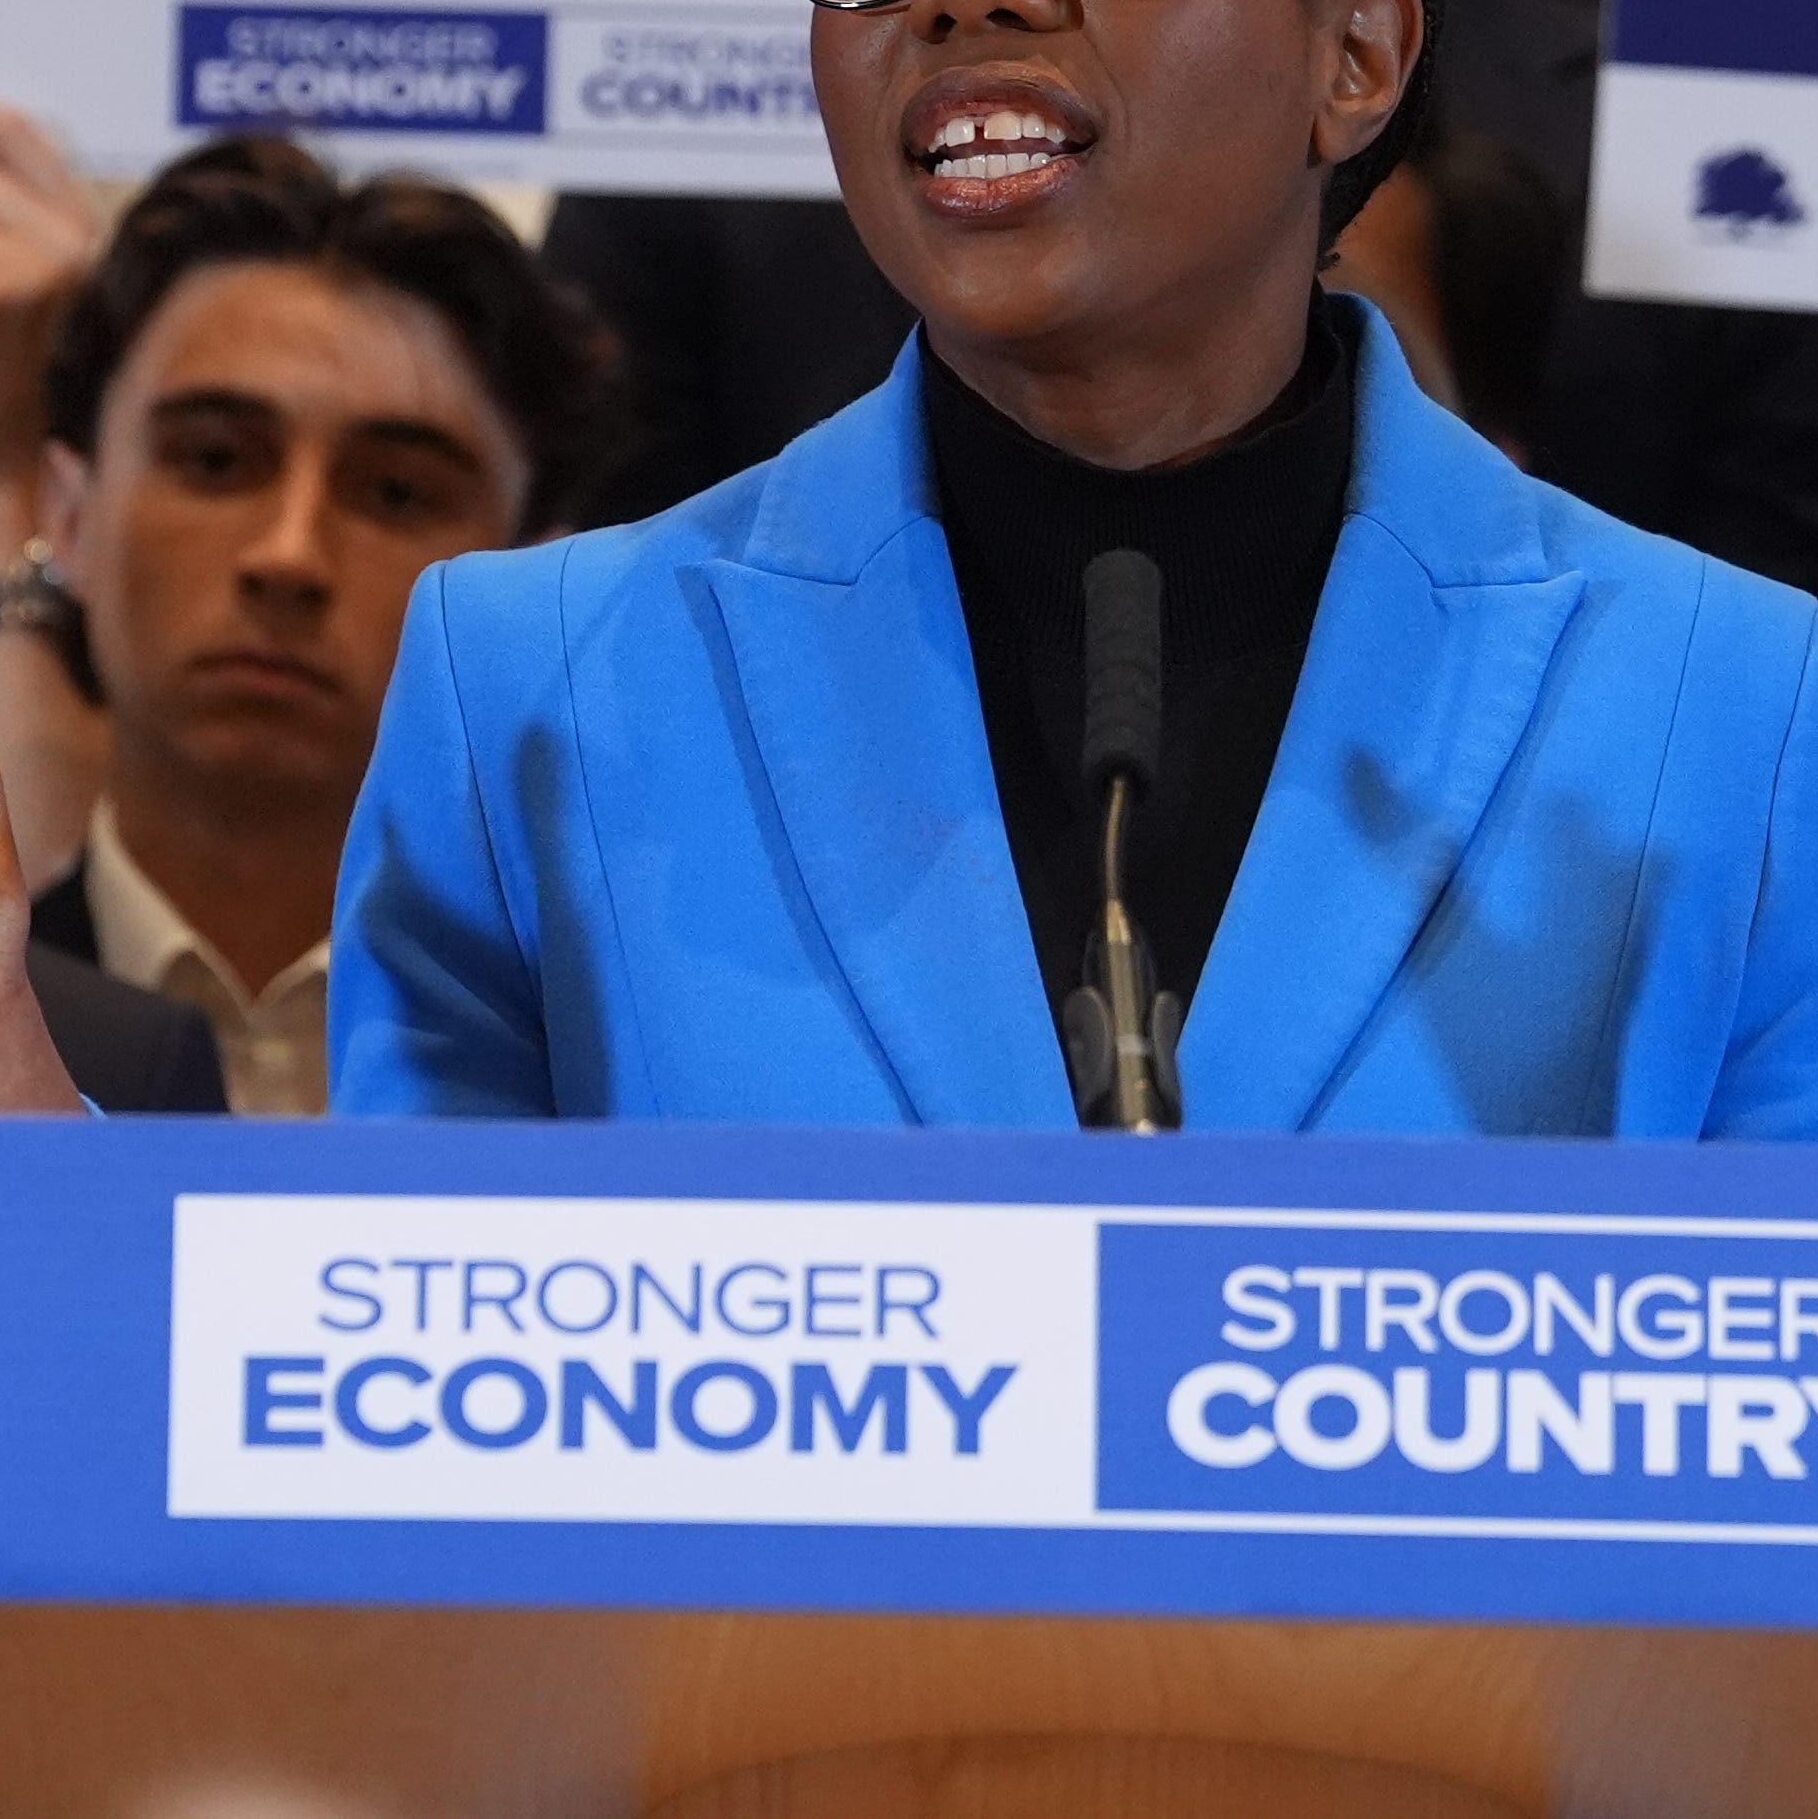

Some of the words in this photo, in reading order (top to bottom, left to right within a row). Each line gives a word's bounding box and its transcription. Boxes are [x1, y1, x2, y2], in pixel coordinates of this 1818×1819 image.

[194, 58, 523, 120] ECONOMY
[317, 1256, 943, 1340] STRONGER
[241, 1353, 1019, 1458] ECONOMY
